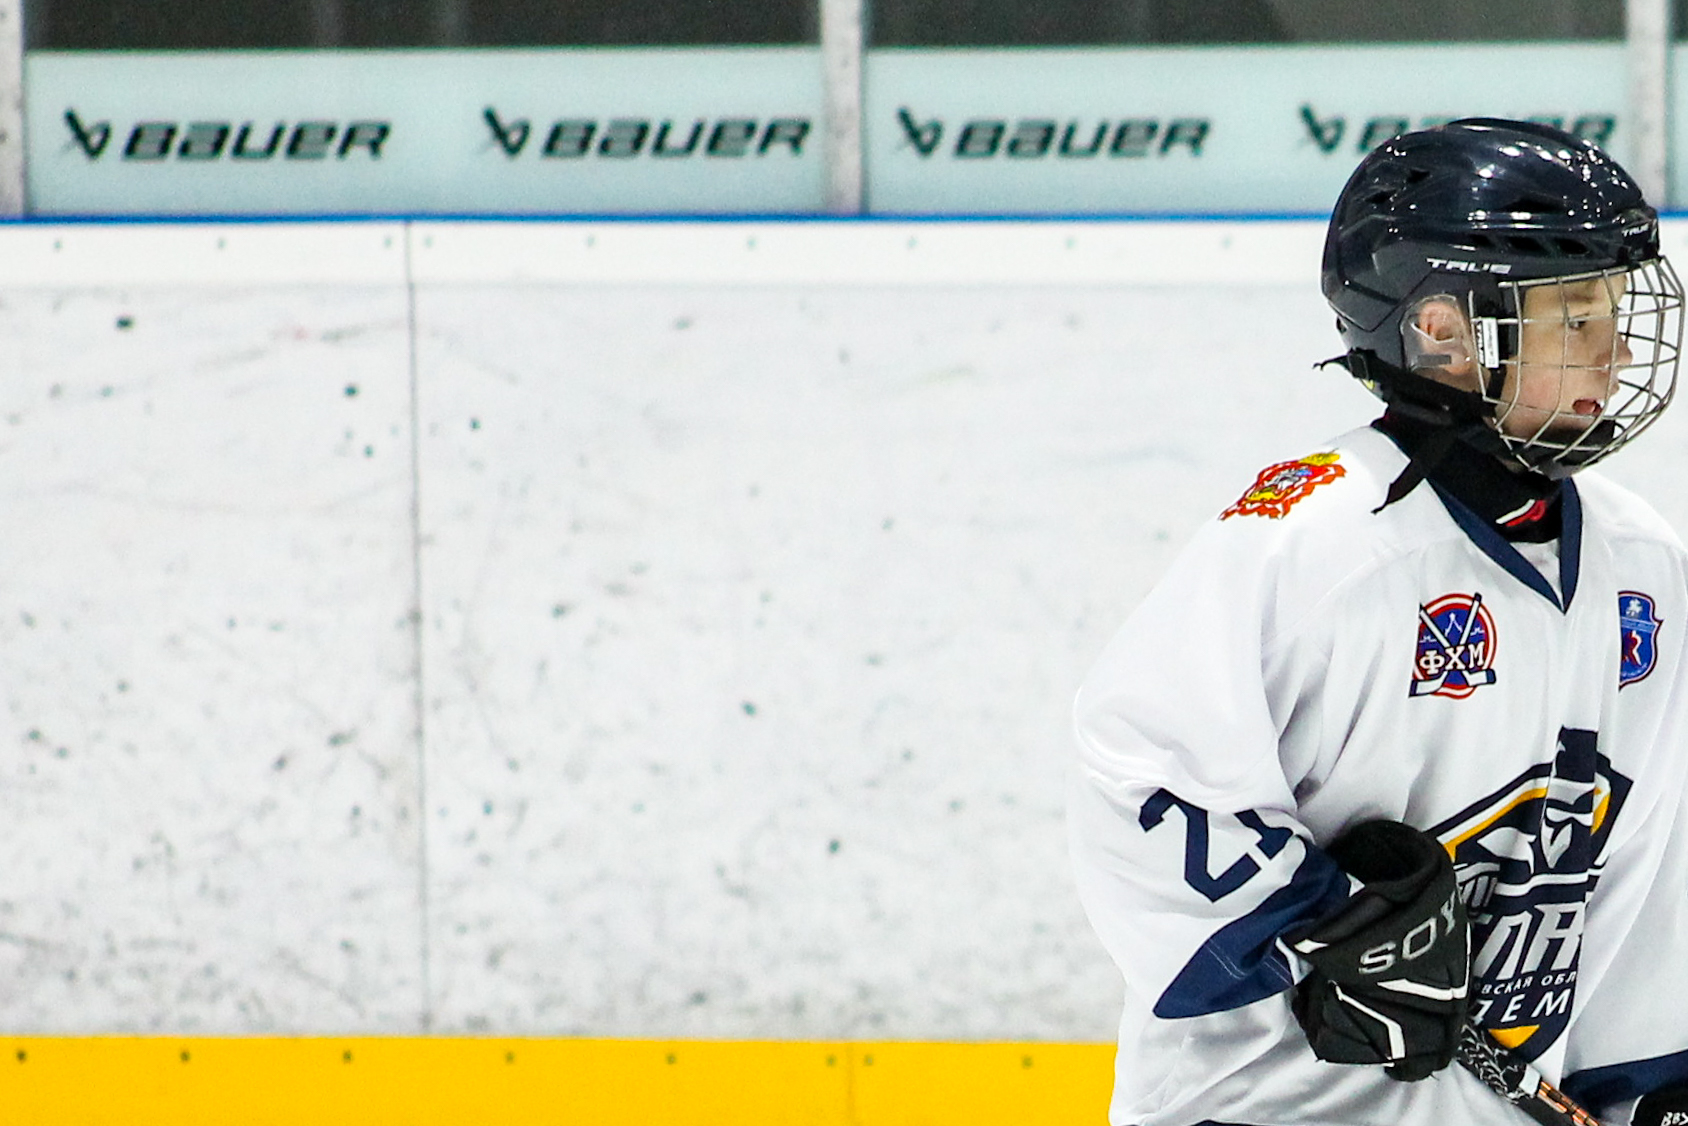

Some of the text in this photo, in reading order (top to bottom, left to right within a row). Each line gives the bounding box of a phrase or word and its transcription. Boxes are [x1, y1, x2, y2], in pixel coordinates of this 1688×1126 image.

[122, 120, 392, 161] BAUER
[540, 118, 812, 158] BAUER
[953, 118, 1211, 160] BAUER
[1621, 223, 1650, 237] TRUE
[1426, 257, 1513, 275] TRUE
[1419, 641, 1485, 675] ФХМ
[1478, 975, 1534, 995] ВСКАЯ
